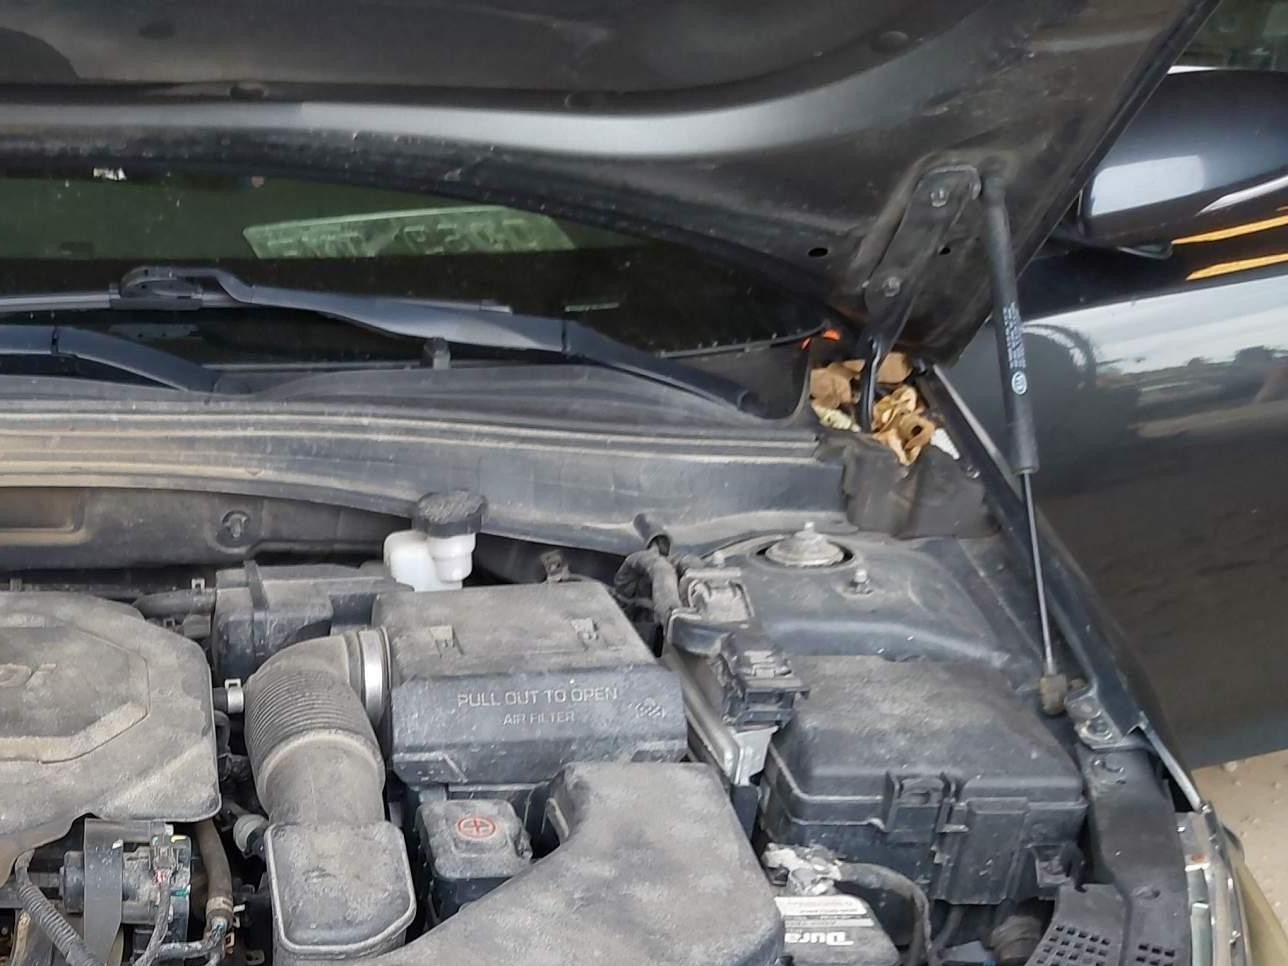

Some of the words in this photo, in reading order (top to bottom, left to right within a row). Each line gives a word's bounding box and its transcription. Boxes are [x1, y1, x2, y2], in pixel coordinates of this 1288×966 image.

[456, 691, 501, 708] PULL
[504, 690, 540, 706] OUT
[543, 688, 567, 704] TO
[569, 686, 618, 703] OPEN
[503, 712, 526, 726] AIR
[529, 711, 576, 725] FILTER
